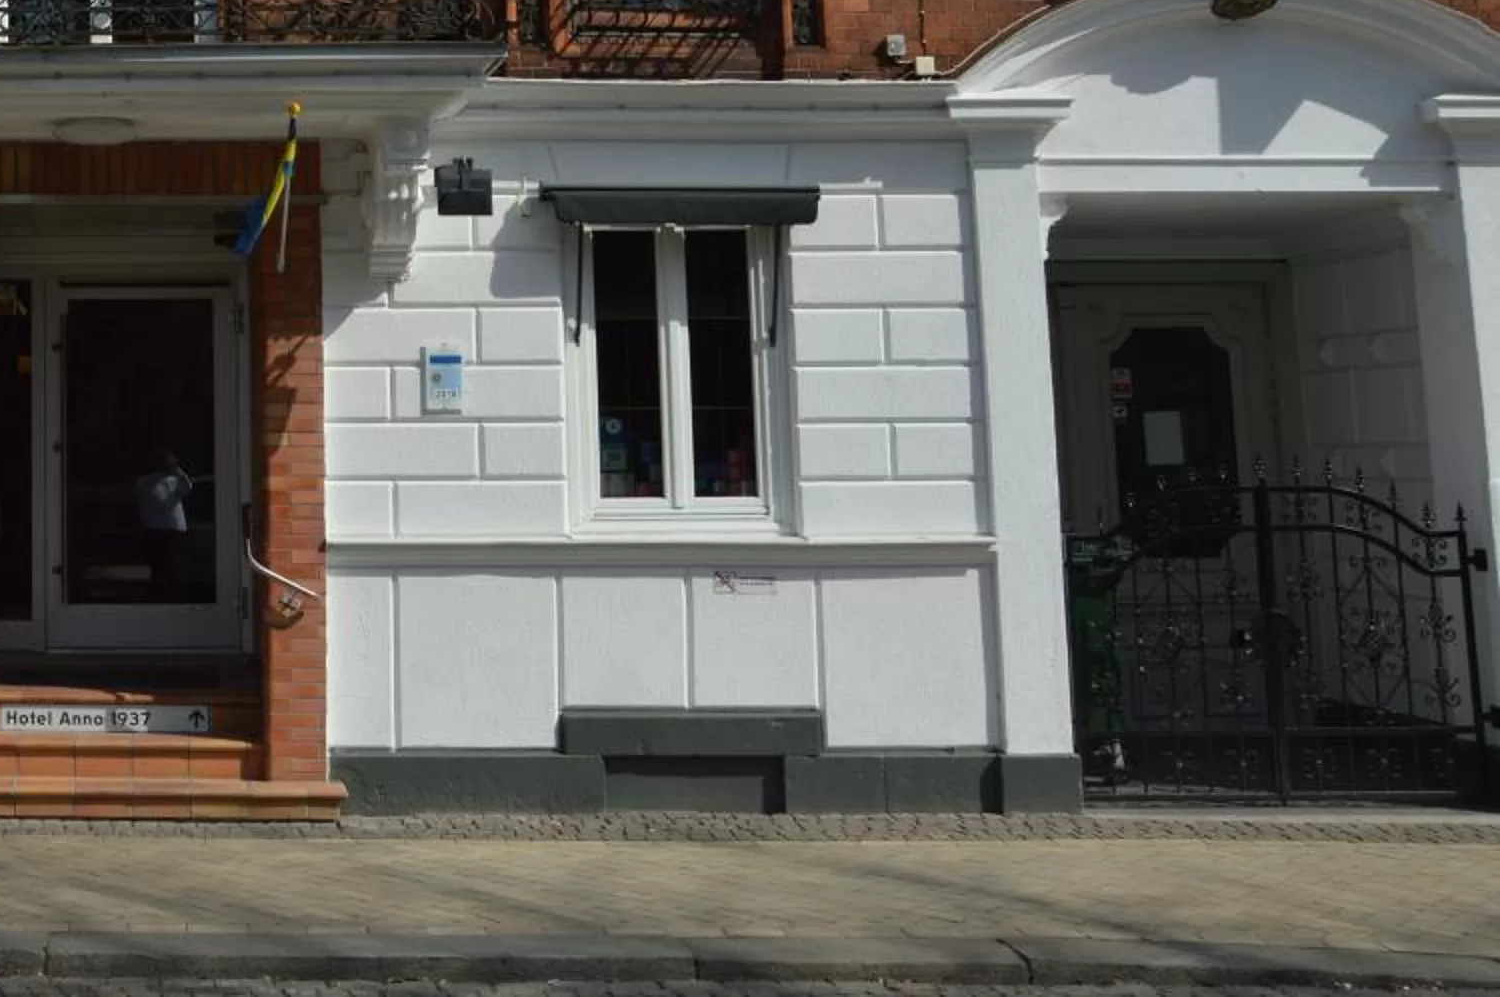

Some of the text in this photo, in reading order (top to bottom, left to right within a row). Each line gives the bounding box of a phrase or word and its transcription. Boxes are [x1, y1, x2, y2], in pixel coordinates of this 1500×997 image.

[6, 711, 151, 726] Hotel Anno 1937
